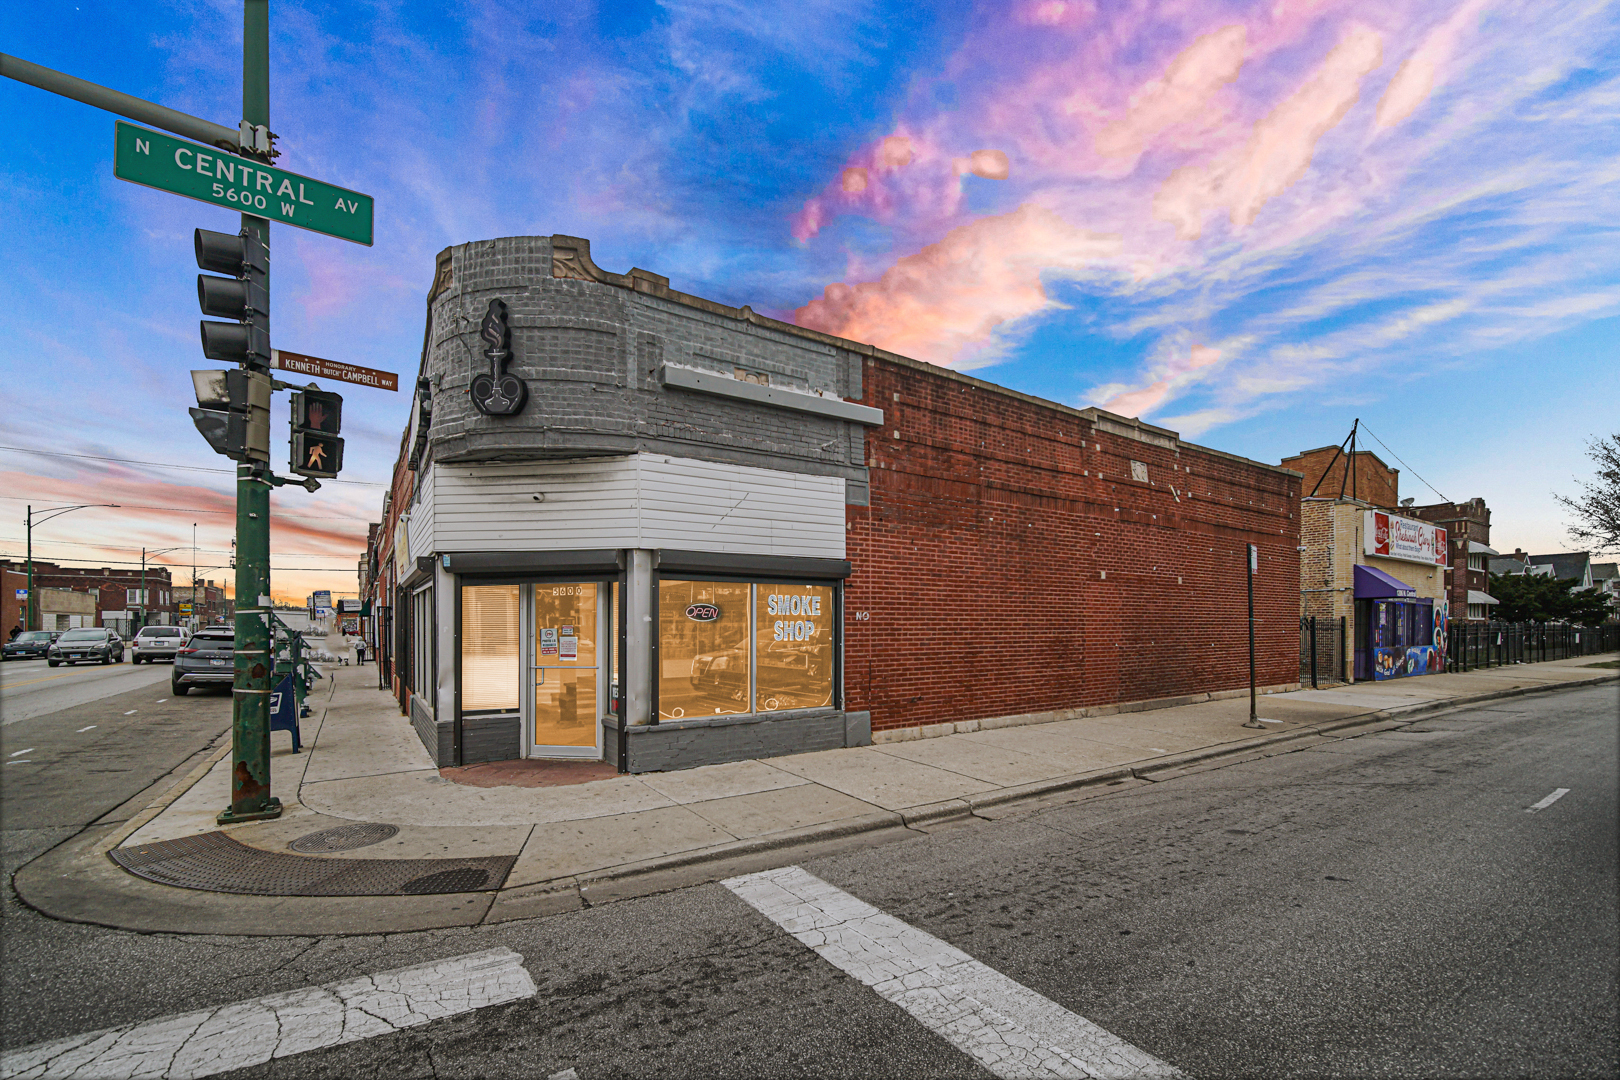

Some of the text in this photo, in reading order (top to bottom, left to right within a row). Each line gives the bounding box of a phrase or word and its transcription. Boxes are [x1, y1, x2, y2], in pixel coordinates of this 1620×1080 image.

[136, 138, 358, 214] N CENTRAL AV
[212, 182, 295, 218] 5600 W
[285, 358, 320, 374] KENNETH
[342, 370, 379, 386] CAMPBELL
[381, 379, 393, 387] WAY
[325, 361, 357, 372] HONORARY
[553, 586, 583, 596] 5600
[685, 606, 719, 618] OPEN
[767, 594, 821, 616] SMOKE
[774, 620, 815, 641] SHOP
